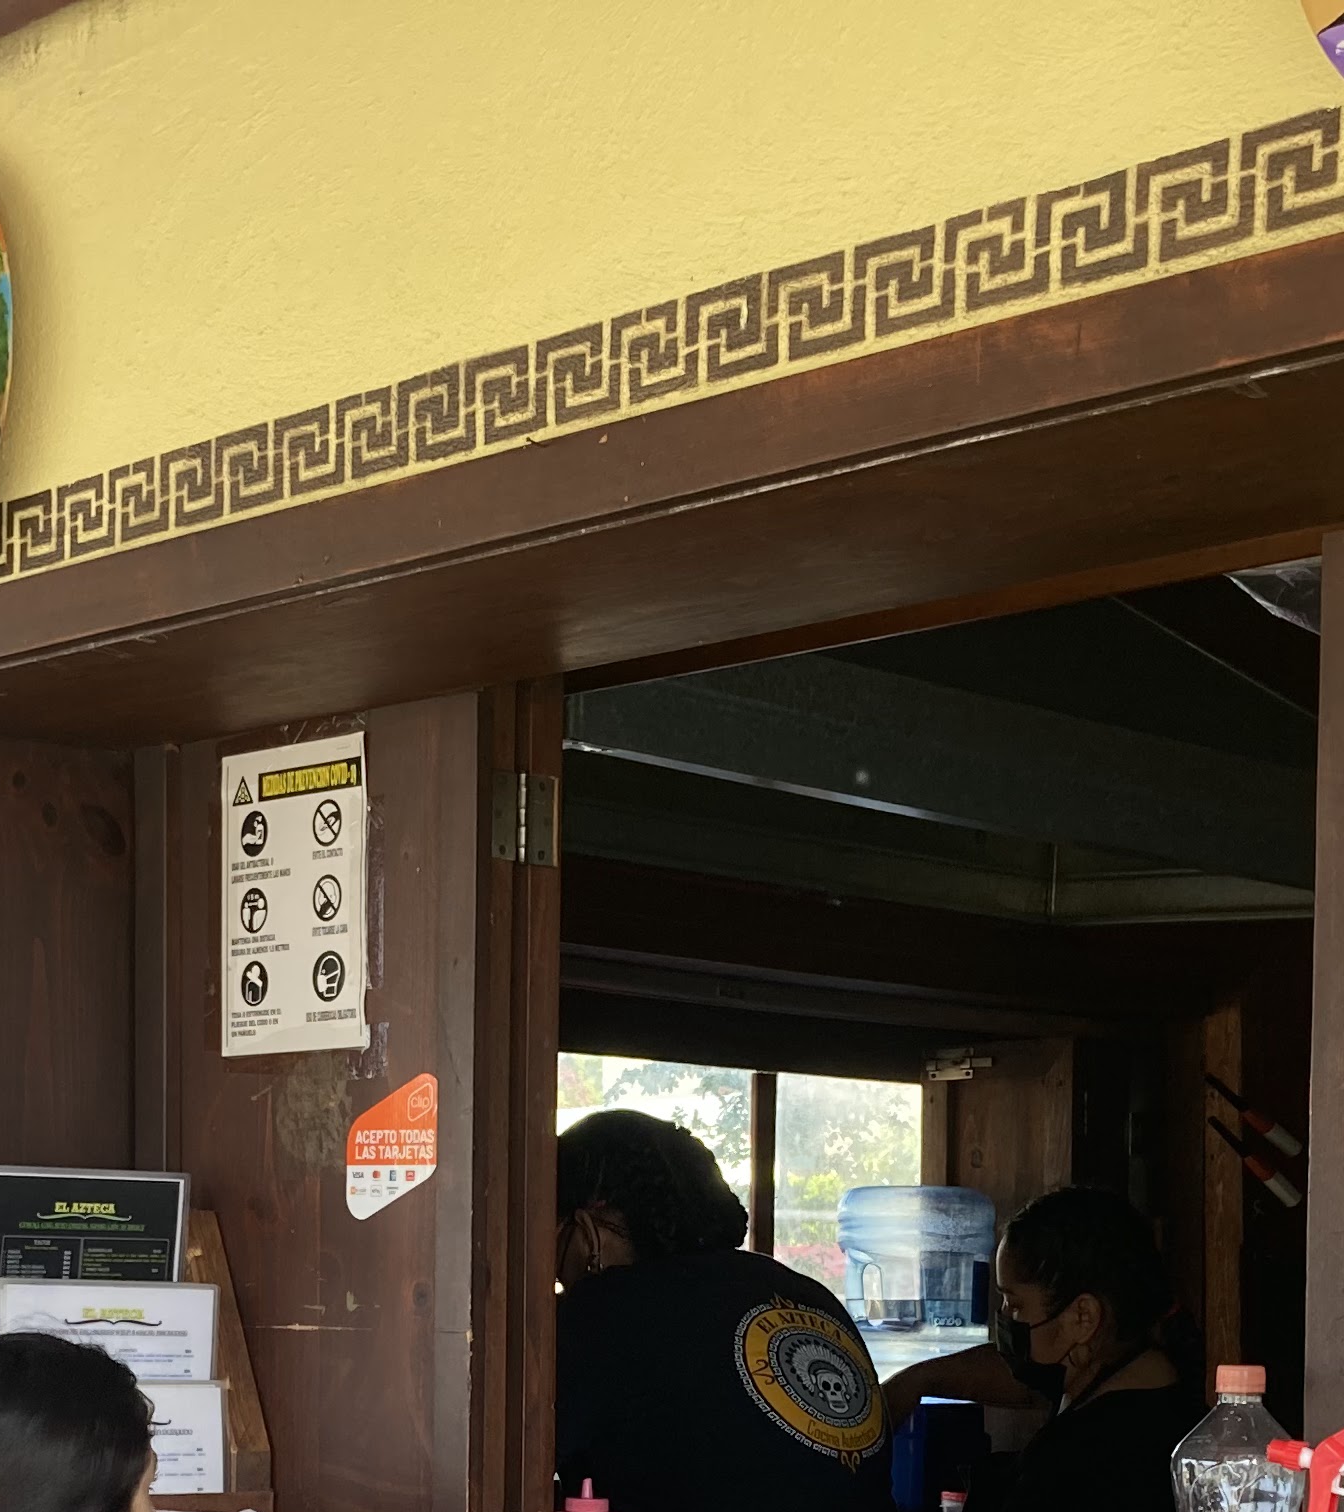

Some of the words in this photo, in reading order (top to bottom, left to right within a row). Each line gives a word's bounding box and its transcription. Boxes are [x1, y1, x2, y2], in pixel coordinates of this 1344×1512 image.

[355, 1130, 398, 1145] ACEPTO
[400, 1129, 434, 1145] TODAS
[355, 1146, 376, 1160] LAS
[378, 1145, 434, 1160] TARJETAS
[55, 1202, 69, 1213] EL
[71, 1203, 115, 1214] AZTECA
[756, 1316, 778, 1334] EL
[777, 1311, 842, 1341] AZTECA
